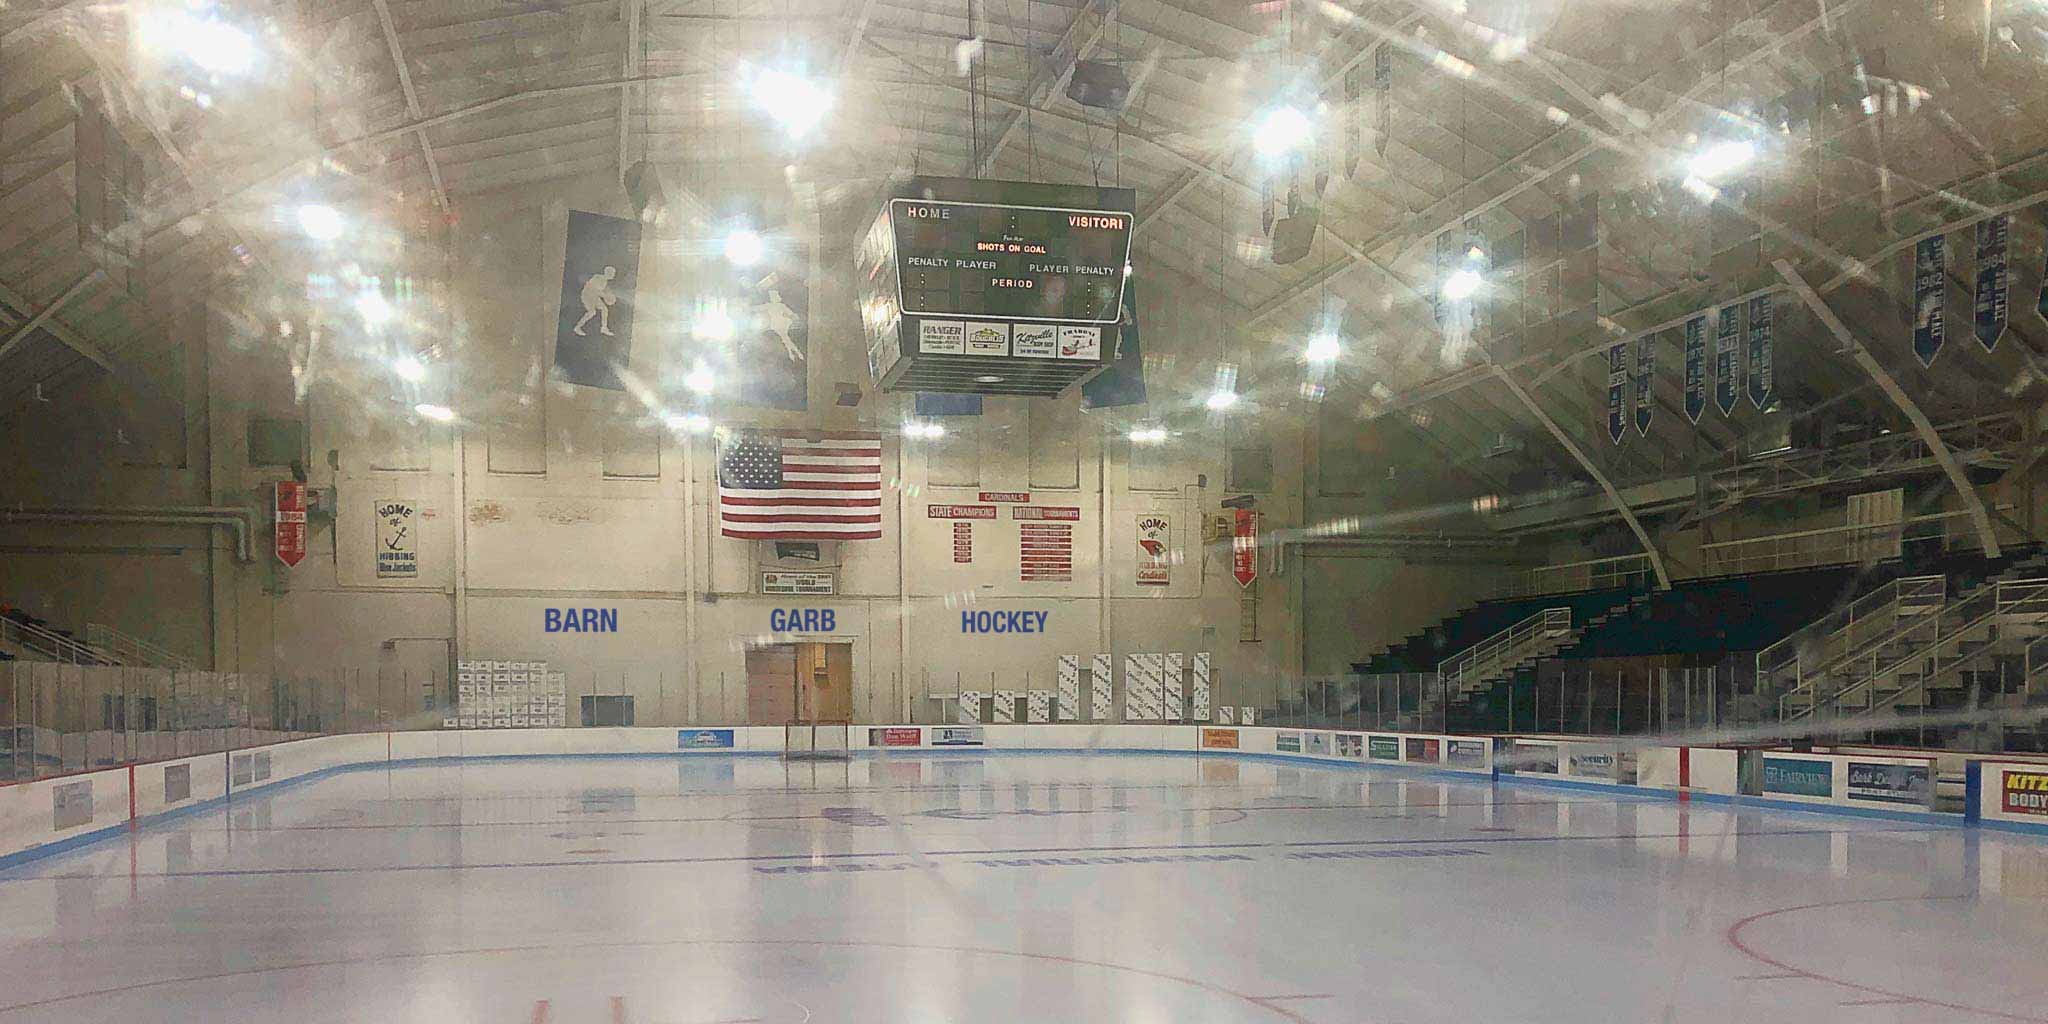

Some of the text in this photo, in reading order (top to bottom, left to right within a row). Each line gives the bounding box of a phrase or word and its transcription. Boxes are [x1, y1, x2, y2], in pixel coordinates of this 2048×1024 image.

[907, 207, 950, 219] HOME
[977, 242, 1005, 252] SHOTS
[1024, 245, 1046, 254] GOAL
[908, 257, 997, 270] PENALTY PLAYER
[1029, 263, 1114, 276] PLAYER PENALTY
[991, 279, 1033, 289] PERIOD
[379, 505, 413, 518] HOME
[930, 506, 994, 517] STATE CHAMPIONS
[1140, 519, 1168, 531] HOME
[1148, 530, 1158, 539] of
[380, 552, 414, 560] HIBBING
